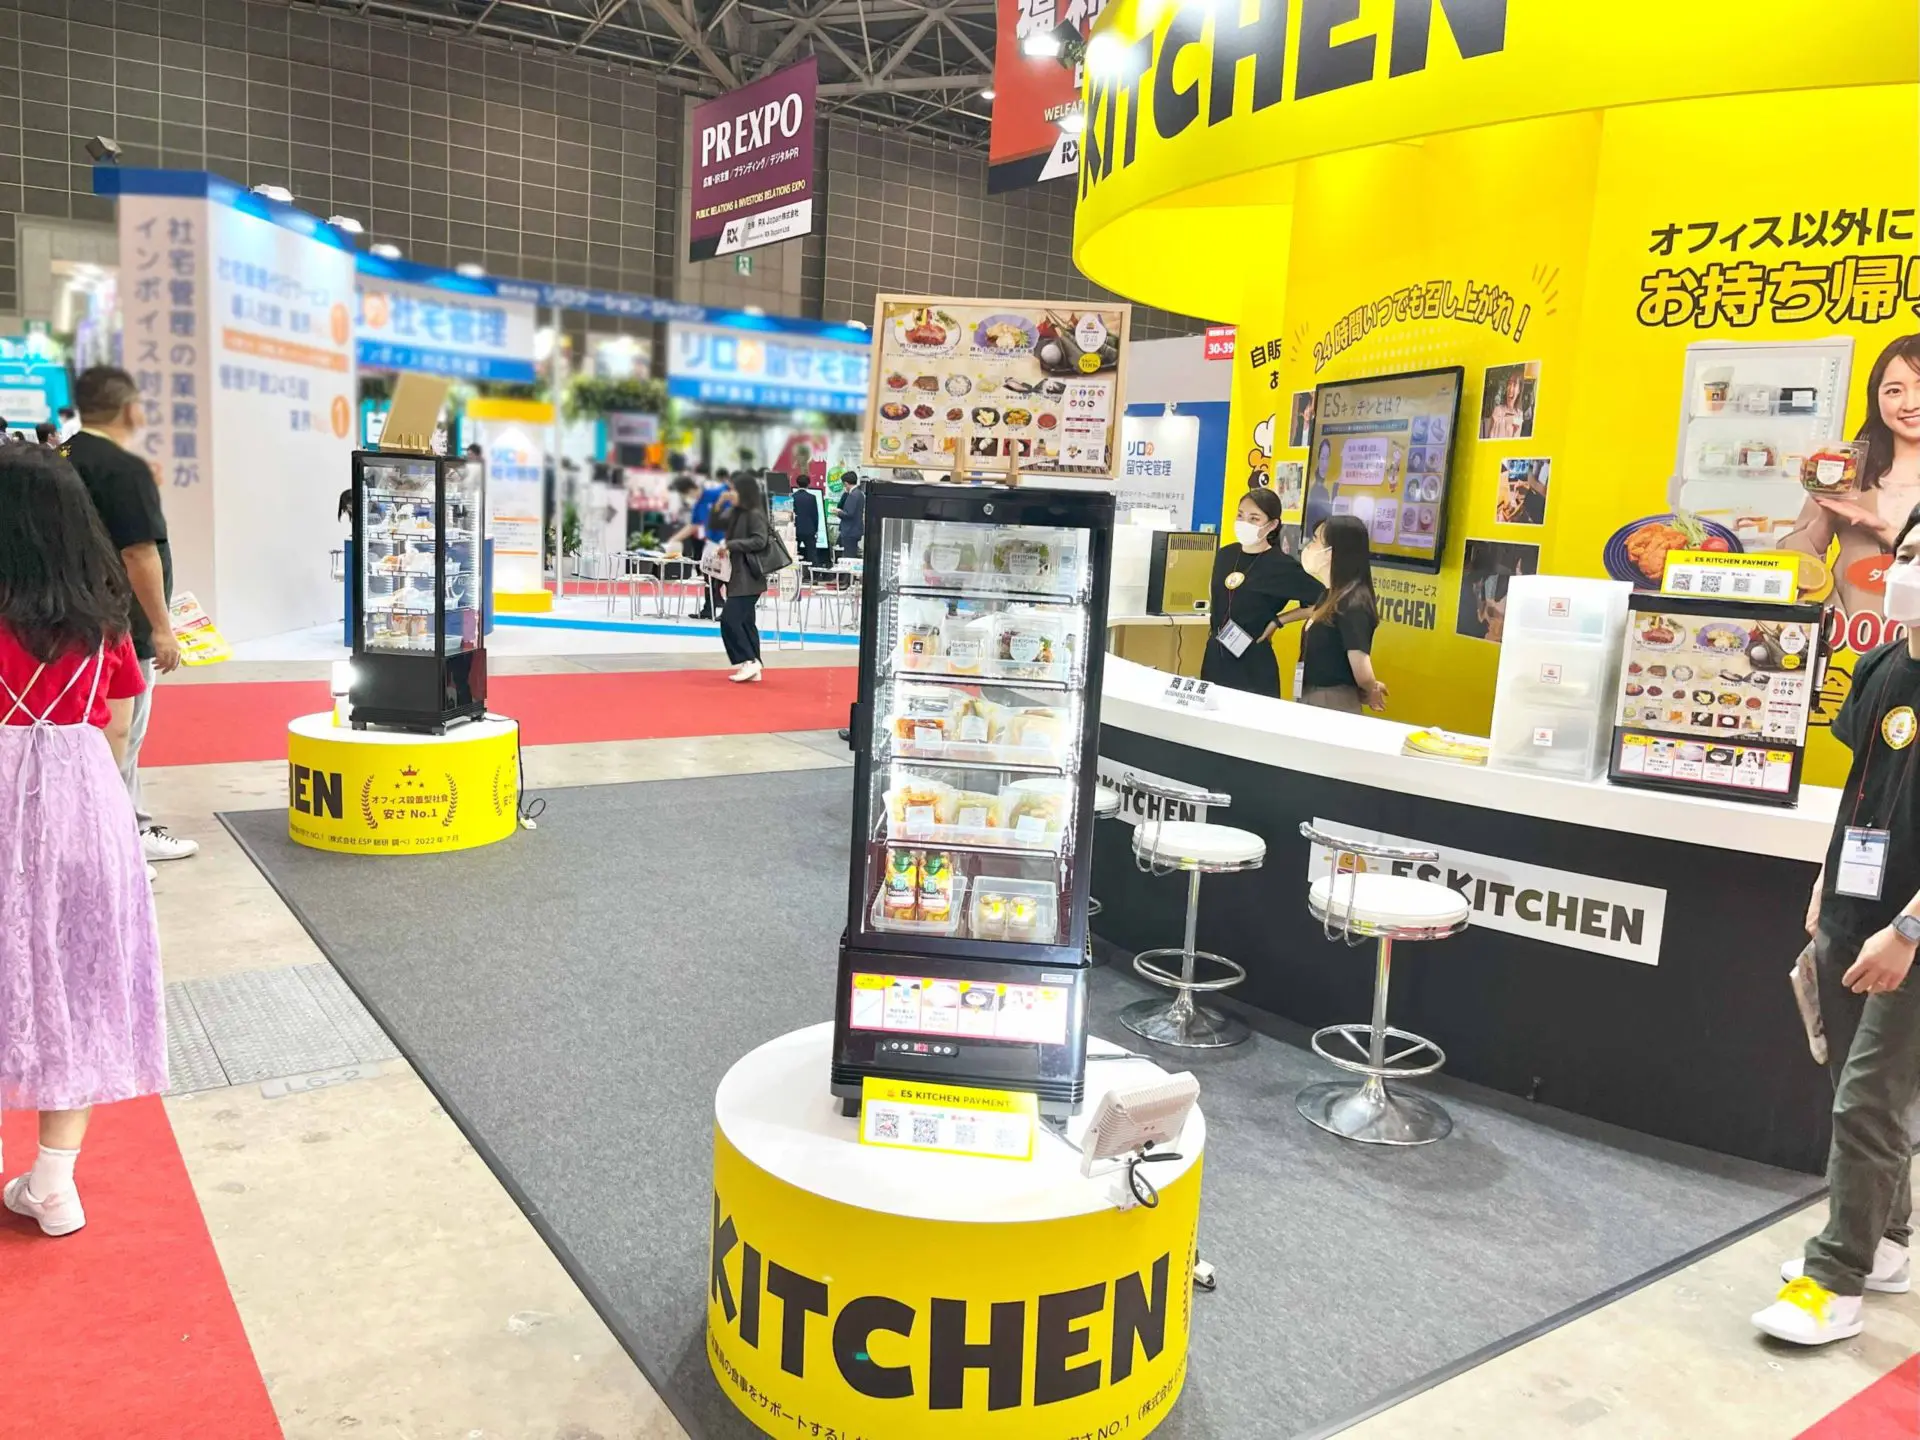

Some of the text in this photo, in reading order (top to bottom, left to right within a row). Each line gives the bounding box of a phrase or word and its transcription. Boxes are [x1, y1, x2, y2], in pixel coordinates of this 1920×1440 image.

[702, 92, 803, 168] PR EXPO
[710, 201, 734, 216] RELATIONS
[764, 184, 791, 200] RELATIONS
[1648, 207, 1915, 256] オフィス以外に
[1706, 556, 1741, 565] KITCHEN
[1742, 558, 1780, 567] PAYMENT
[410, 808, 438, 819] No.1
[900, 1089, 1011, 1107] ES KITCHEN PAYMENT
[711, 1188, 1170, 1412] KITCHEN
